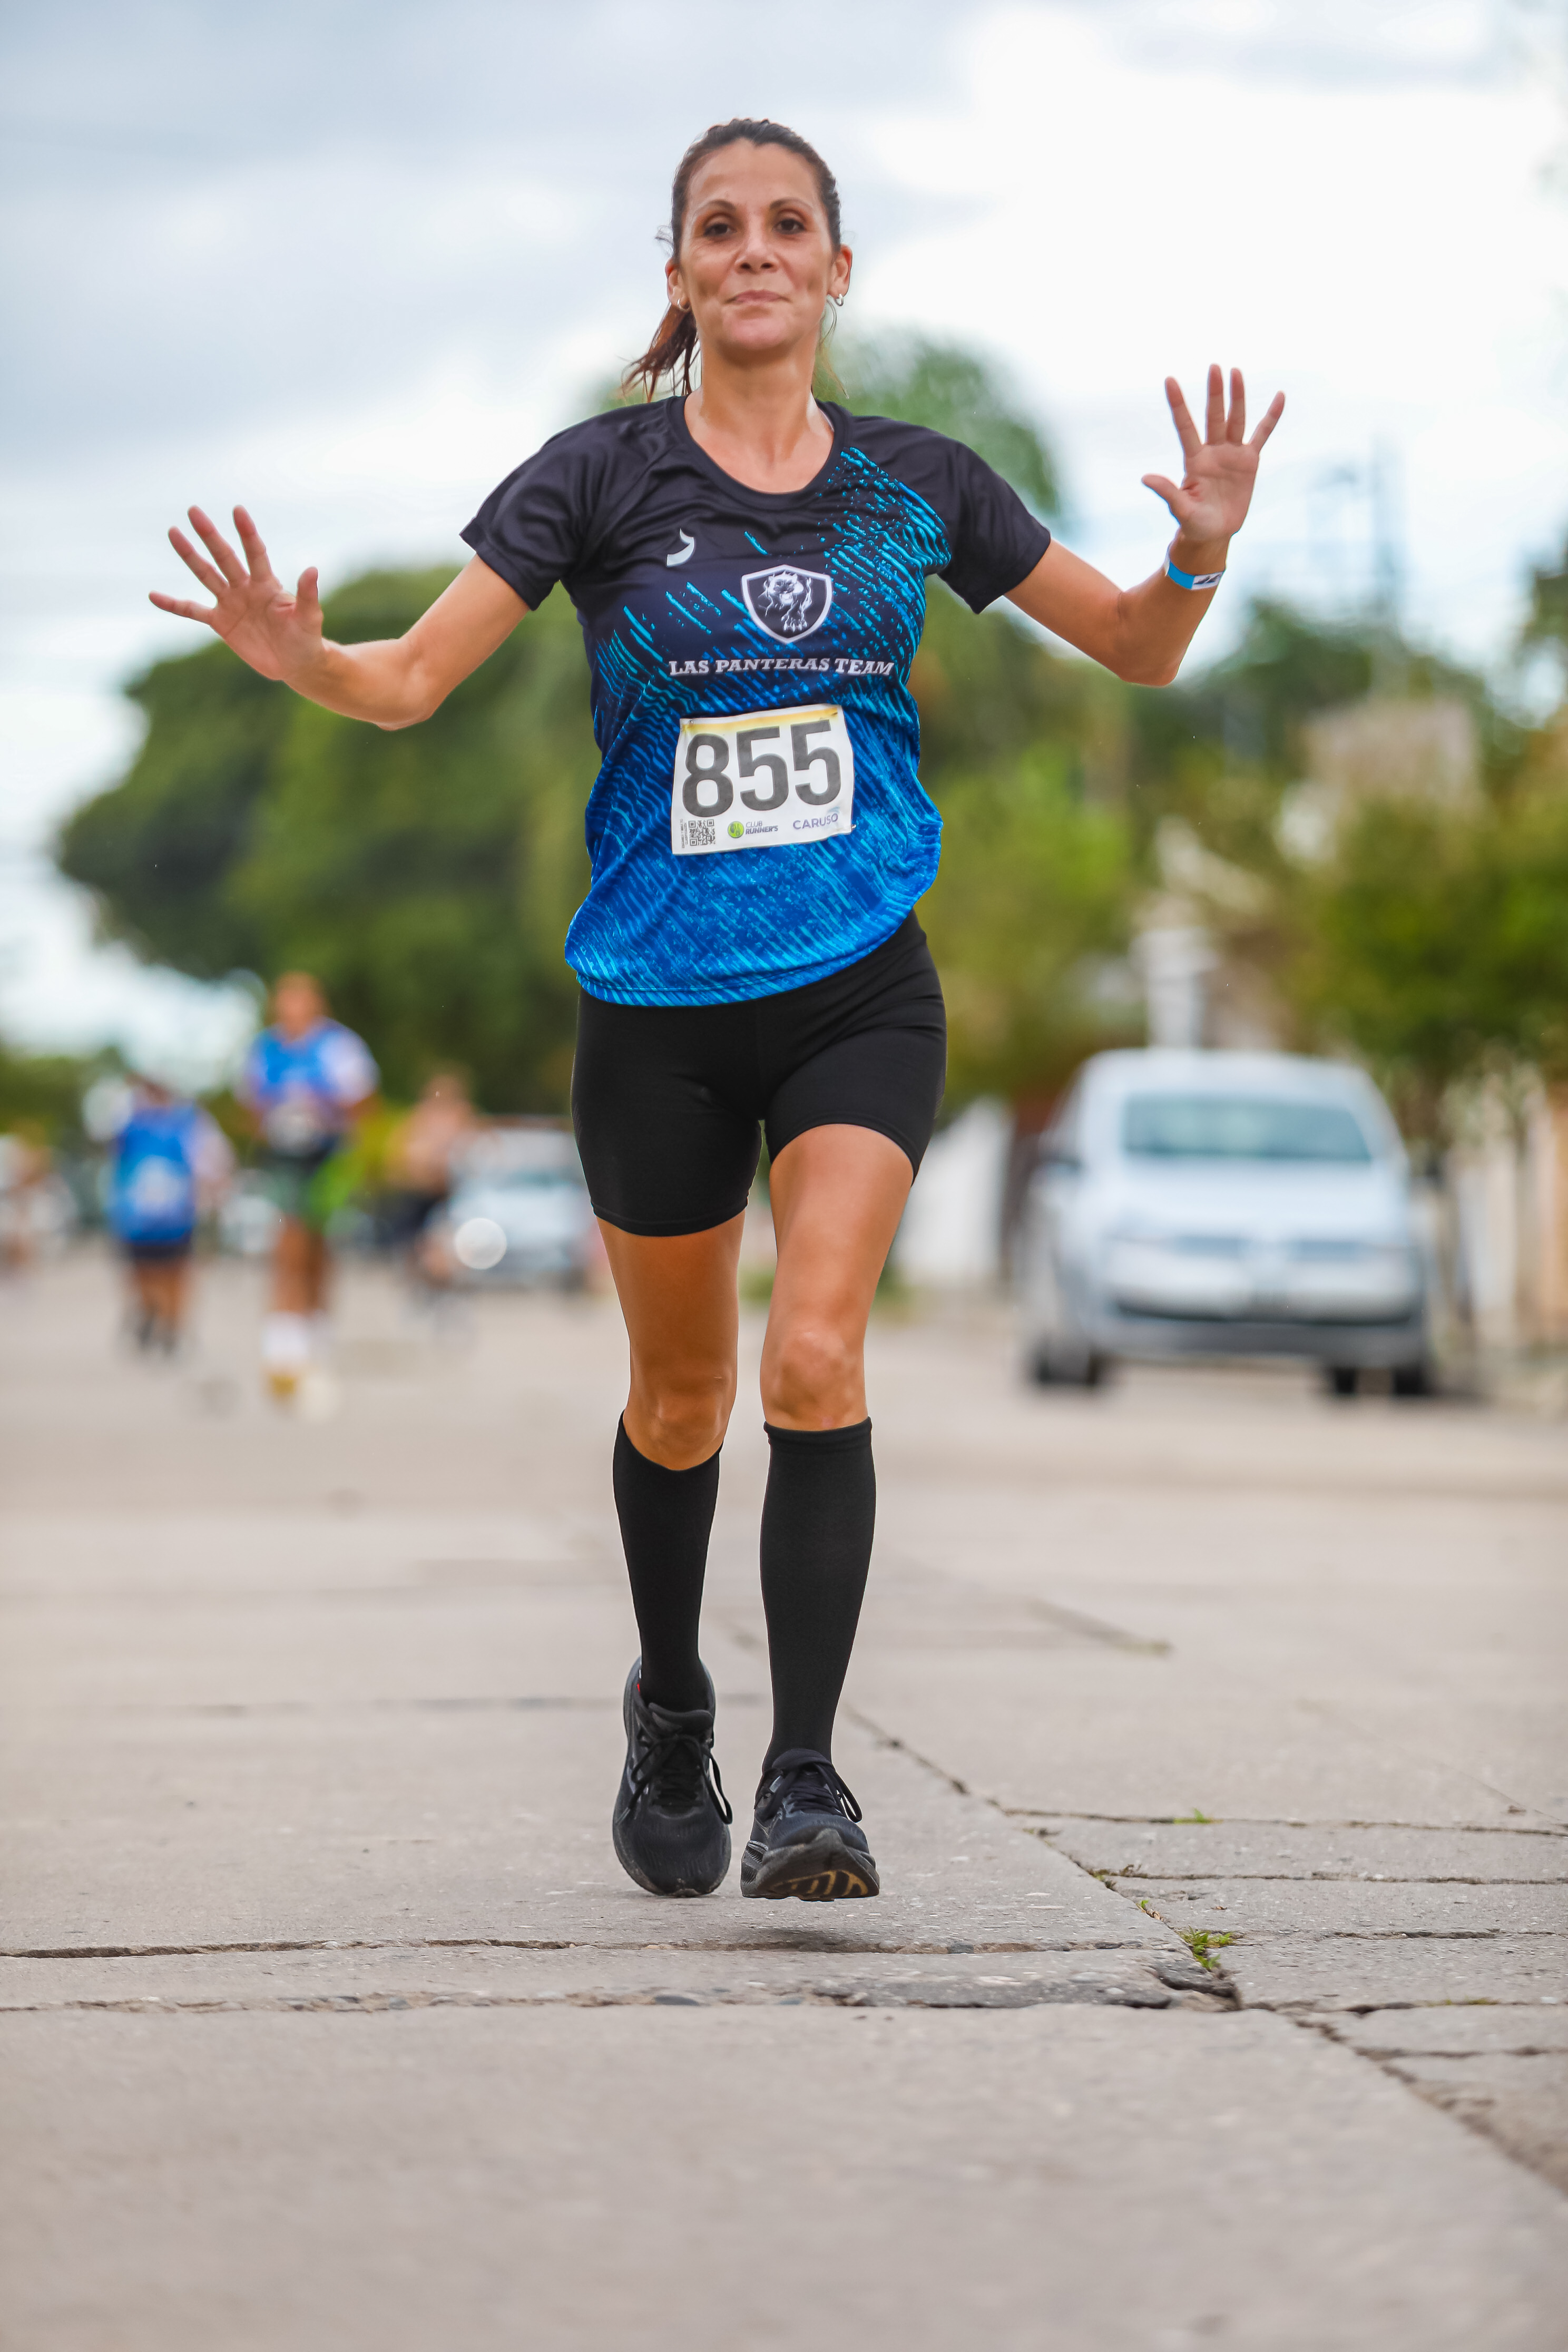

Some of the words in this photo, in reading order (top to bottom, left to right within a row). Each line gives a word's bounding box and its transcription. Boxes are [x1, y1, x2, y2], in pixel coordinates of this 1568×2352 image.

[669, 660, 709, 676] LAS
[715, 658, 830, 673] PANTERAS
[834, 658, 895, 676] TEAM
[682, 720, 841, 817] 855
[745, 825, 779, 835] RUNNER'S
[792, 813, 838, 830] CARUSO
